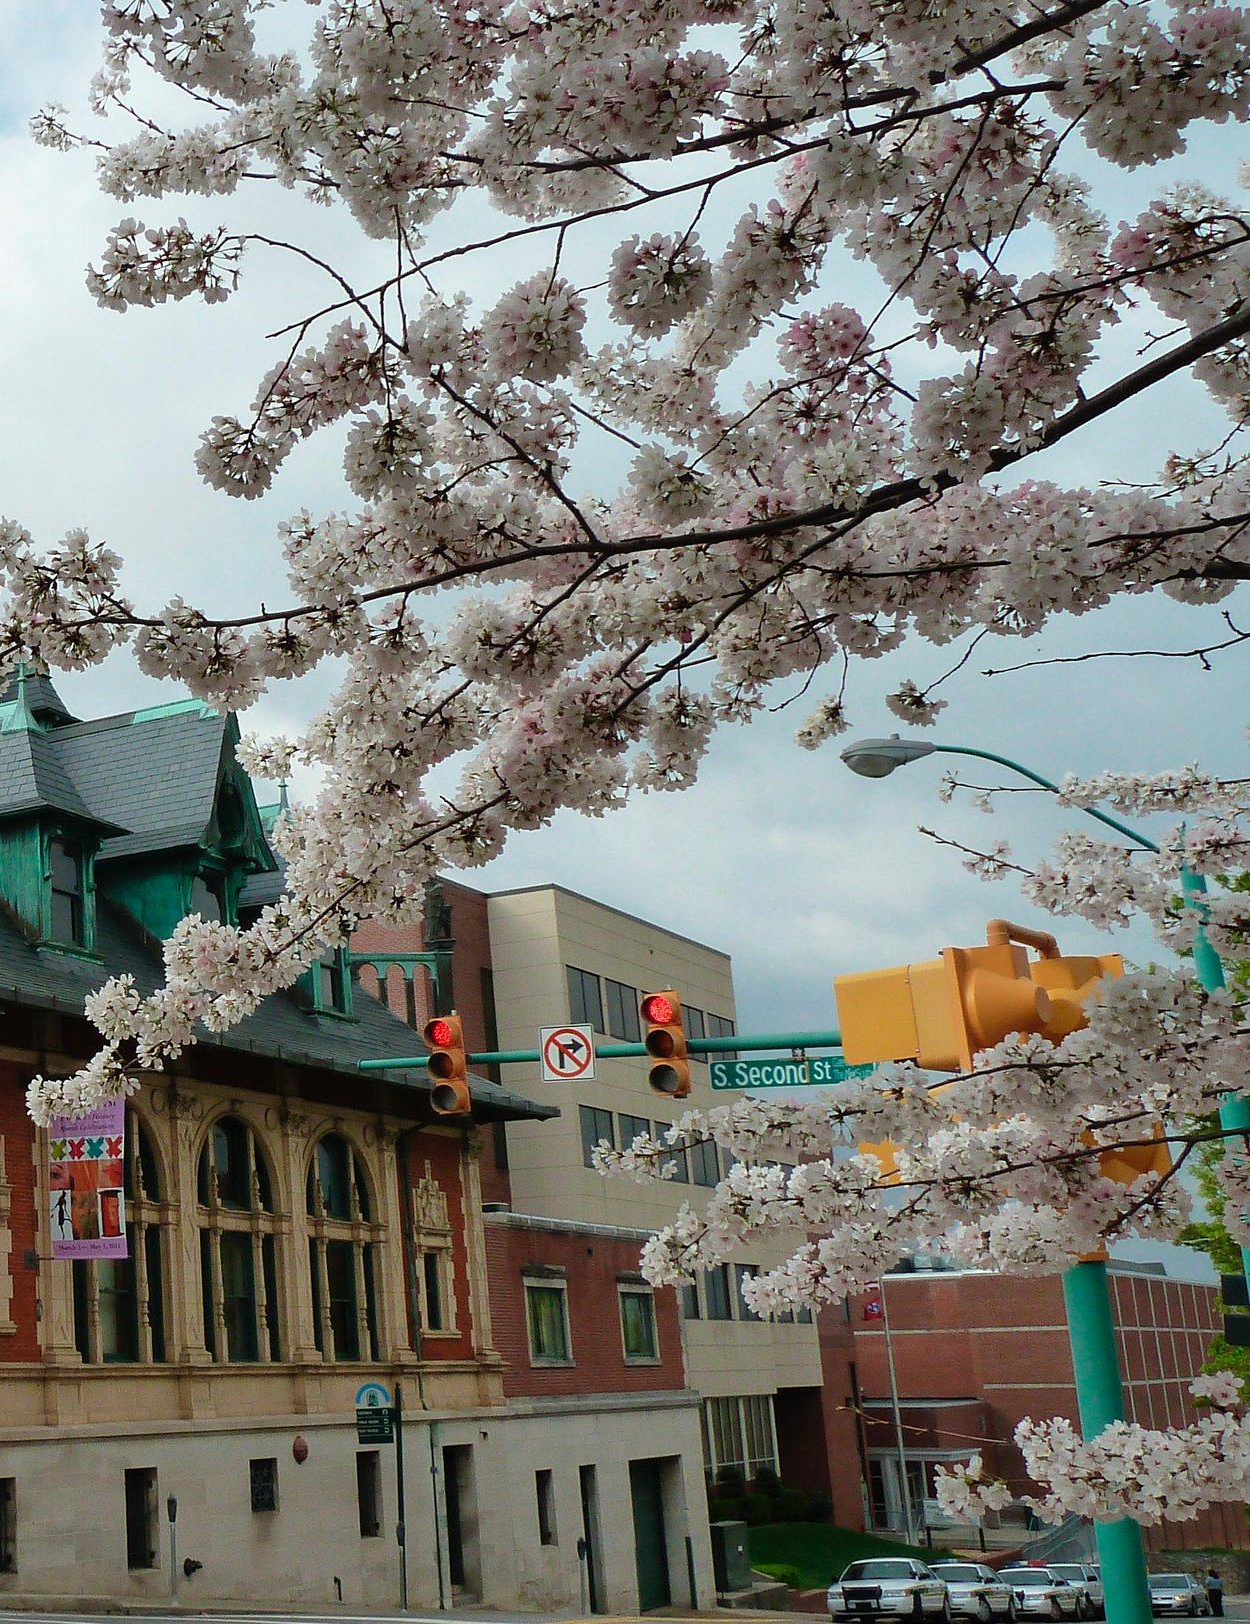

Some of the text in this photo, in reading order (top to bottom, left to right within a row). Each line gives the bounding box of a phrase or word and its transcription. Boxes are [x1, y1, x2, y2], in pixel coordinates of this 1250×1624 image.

[714, 1063, 732, 1087] S.
[735, 1062, 810, 1086] Second
[813, 1061, 831, 1080] St
